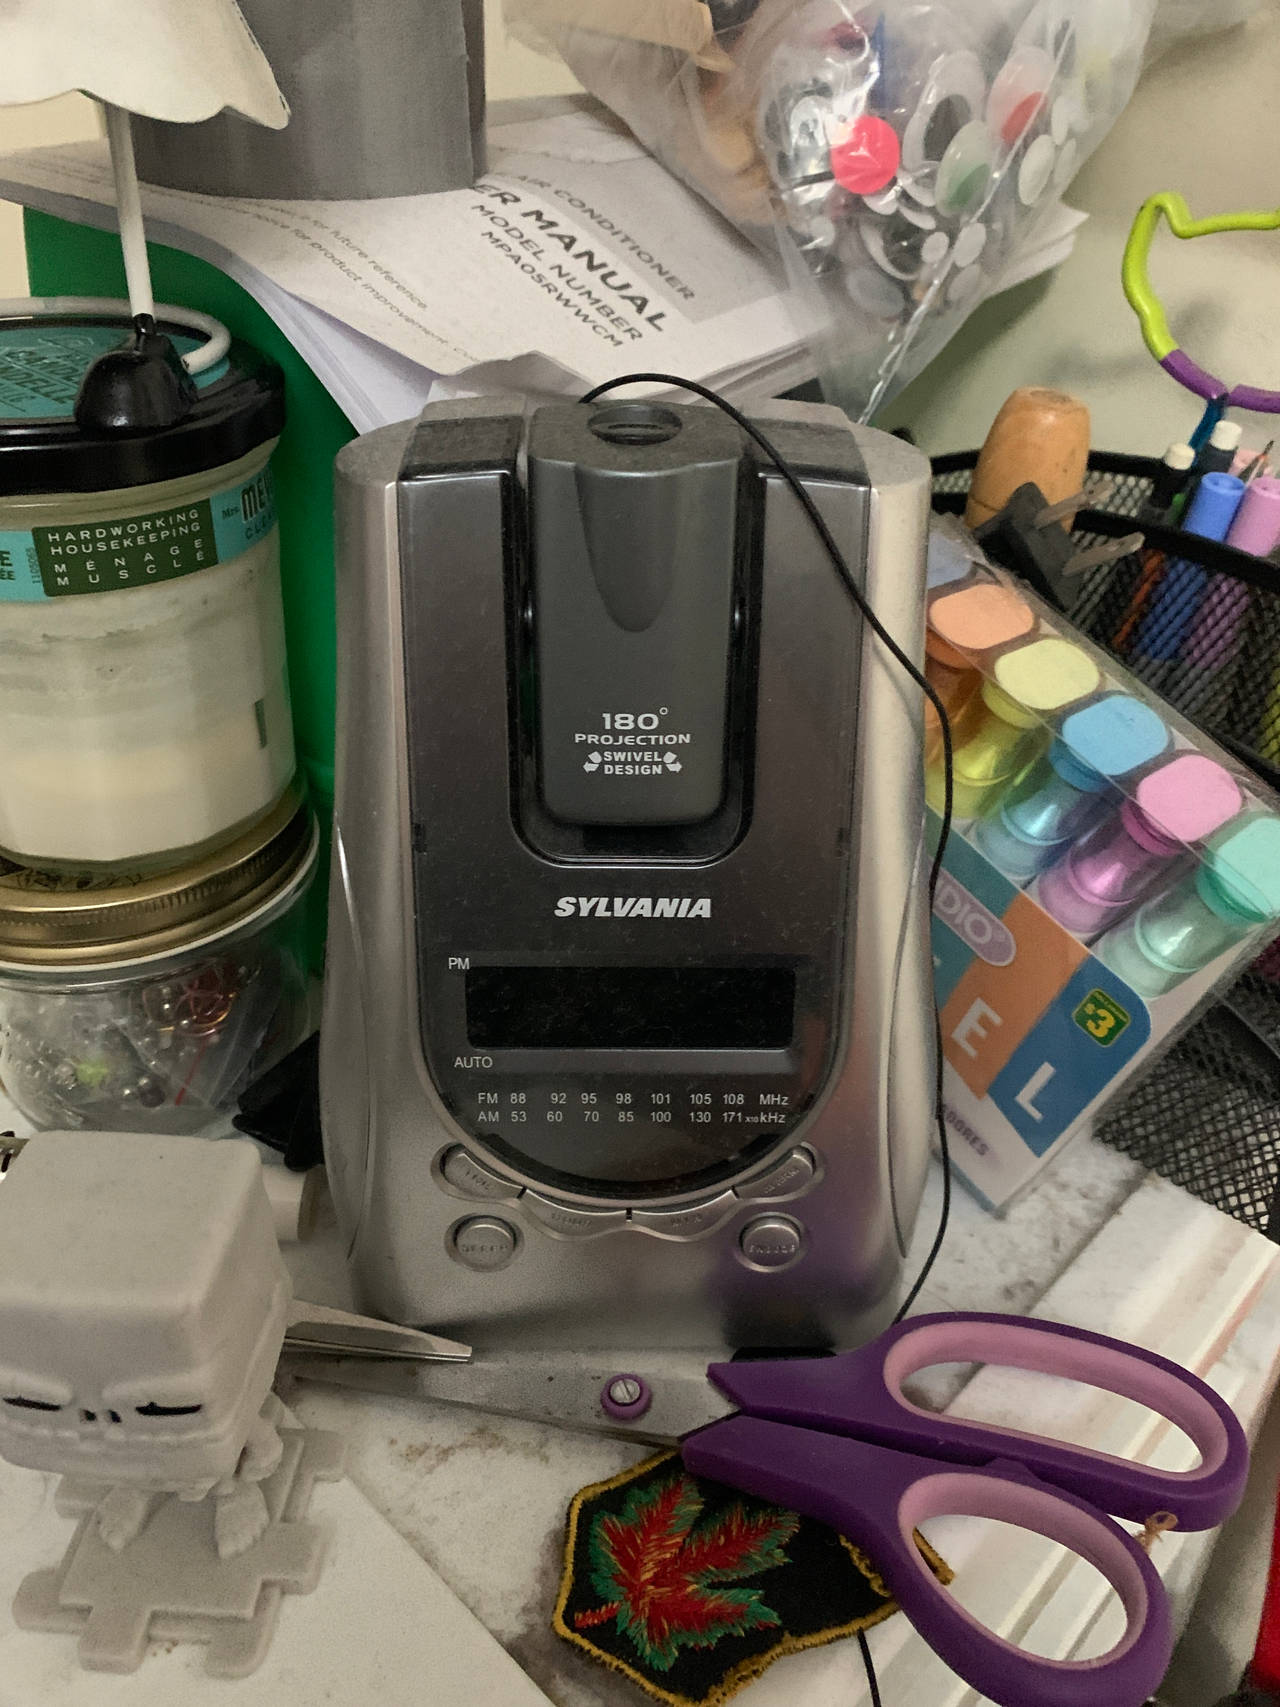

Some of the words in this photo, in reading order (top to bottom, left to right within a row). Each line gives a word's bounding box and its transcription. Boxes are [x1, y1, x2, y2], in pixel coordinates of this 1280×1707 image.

[329, 229, 368, 259] future
[554, 189, 695, 300] CONDITIONER
[309, 242, 362, 282] product
[473, 183, 521, 206] ER
[521, 209, 667, 333] MANUAL
[471, 204, 547, 262] MODEL
[550, 264, 644, 341] NUMBER
[48, 509, 199, 542] HARDWORKING
[51, 522, 200, 555] HOUSEKEEPING
[574, 733, 691, 745] PROJECTION
[603, 751, 663, 762] SWIVEL
[603, 764, 663, 775] DESIGN
[554, 896, 712, 918] SYLVANIA
[938, 886, 993, 944] DIO
[448, 957, 470, 970] PM
[453, 1056, 494, 1069] AUTO
[477, 1092, 499, 1105] FM
[510, 1092, 527, 1105] 88
[550, 1092, 567, 1105] 92
[580, 1092, 598, 1105] 95
[615, 1092, 633, 1105] 98
[650, 1093, 671, 1105] 101
[689, 1093, 712, 1105] 105
[722, 1093, 745, 1105] 108
[759, 1093, 790, 1106] MHz
[476, 1110, 500, 1123] AM
[511, 1110, 527, 1123] 53
[546, 1110, 563, 1123] 60
[583, 1110, 600, 1123] 70
[617, 1110, 635, 1123] 85
[650, 1111, 672, 1123] 100
[689, 1111, 712, 1123] 130
[722, 1111, 742, 1123] 171
